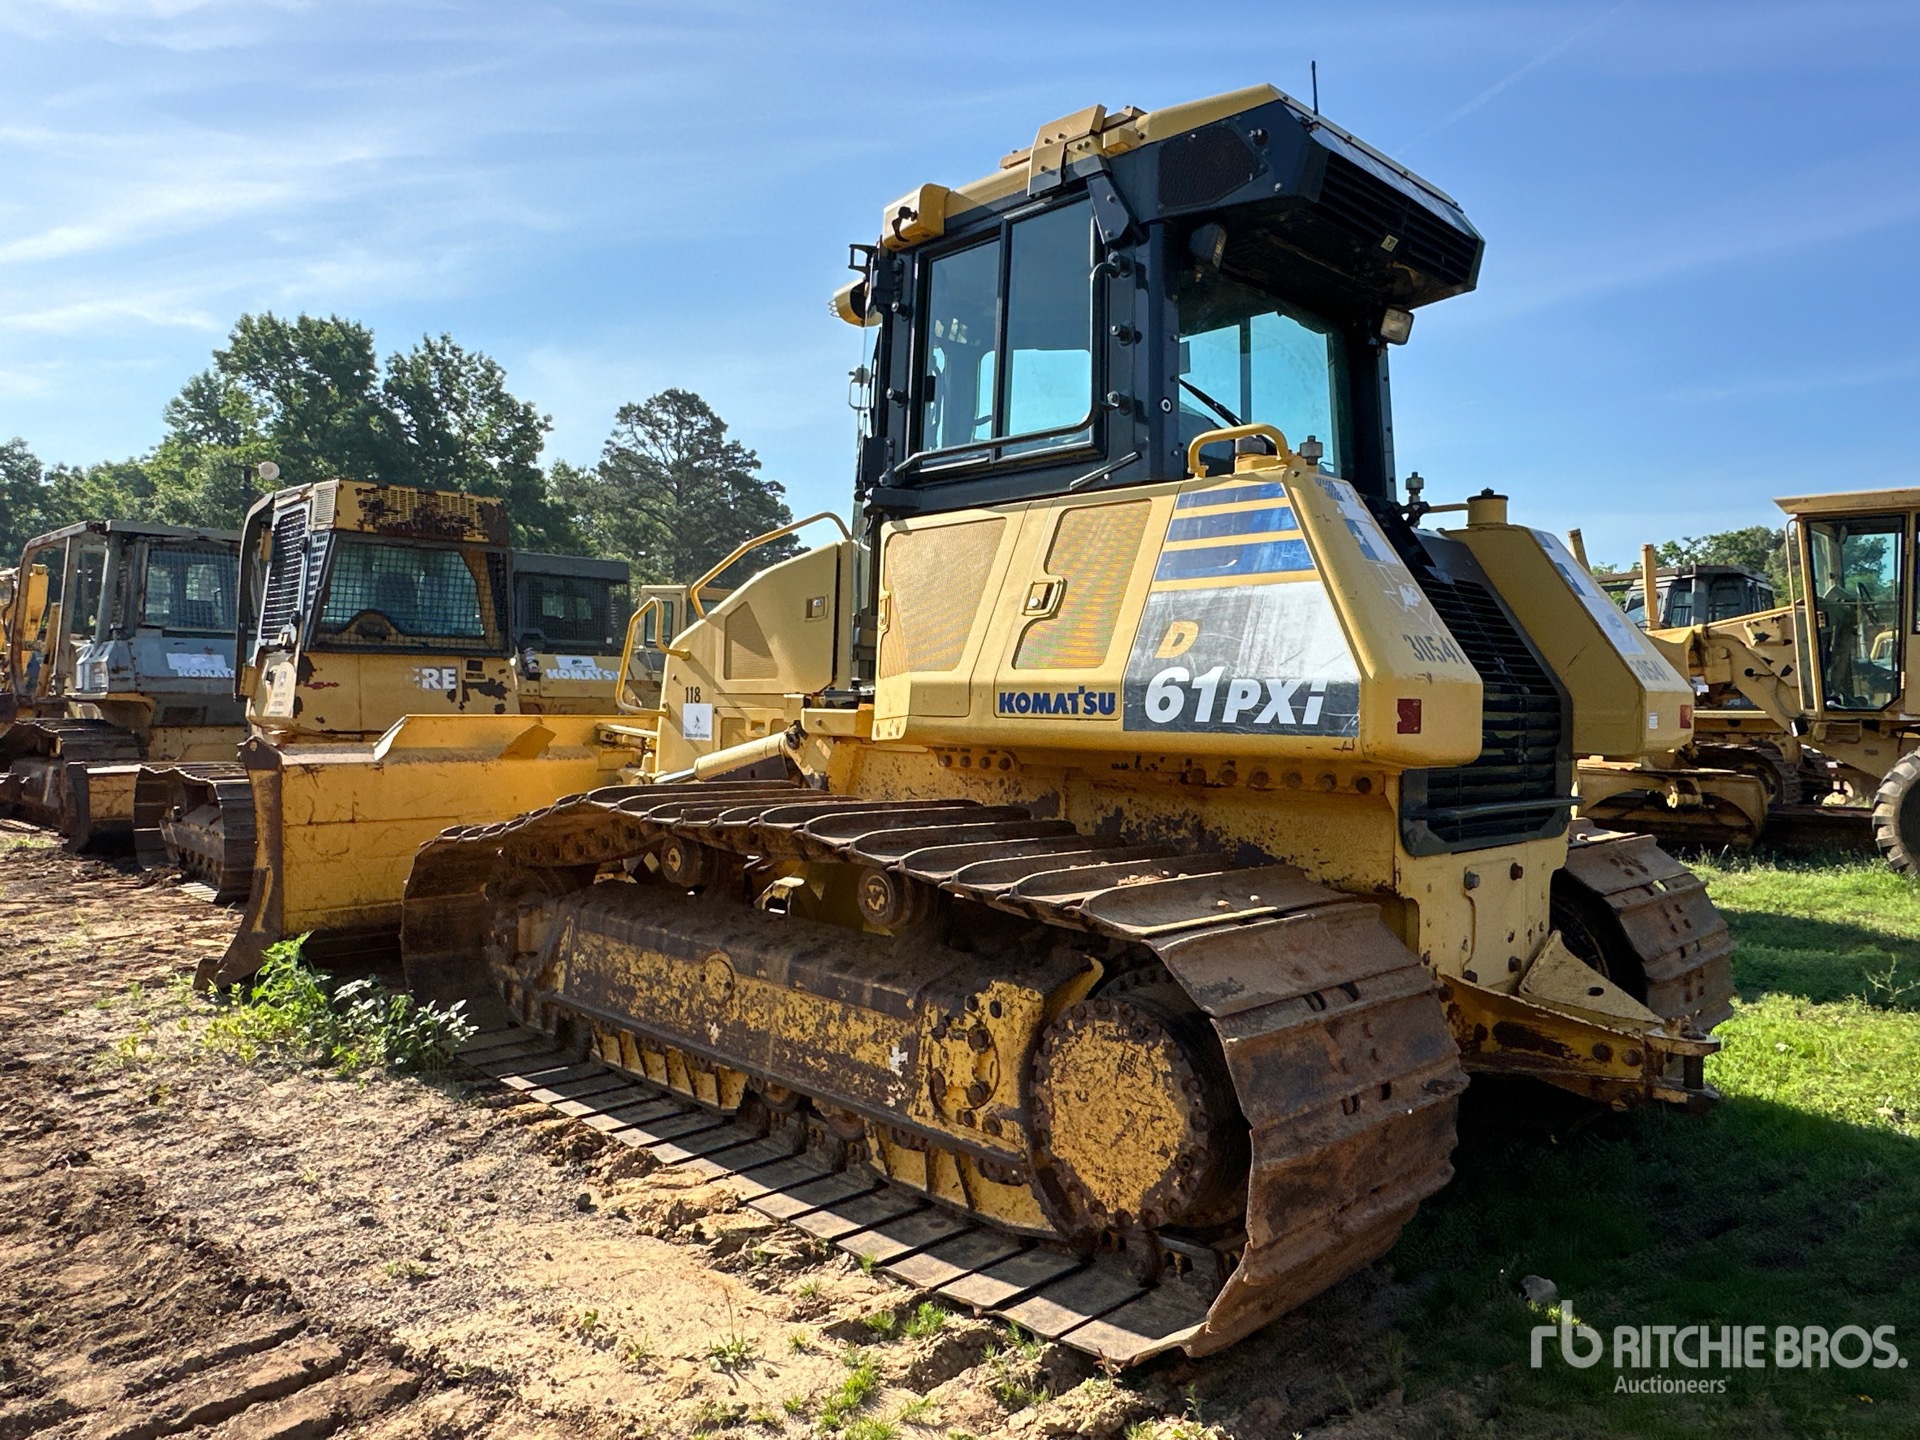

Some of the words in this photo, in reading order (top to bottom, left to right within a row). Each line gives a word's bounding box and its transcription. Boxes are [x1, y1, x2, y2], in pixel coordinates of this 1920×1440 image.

[1154, 621, 1199, 659] D
[685, 686, 701, 704] 118
[999, 685, 1116, 715] KOMATSU
